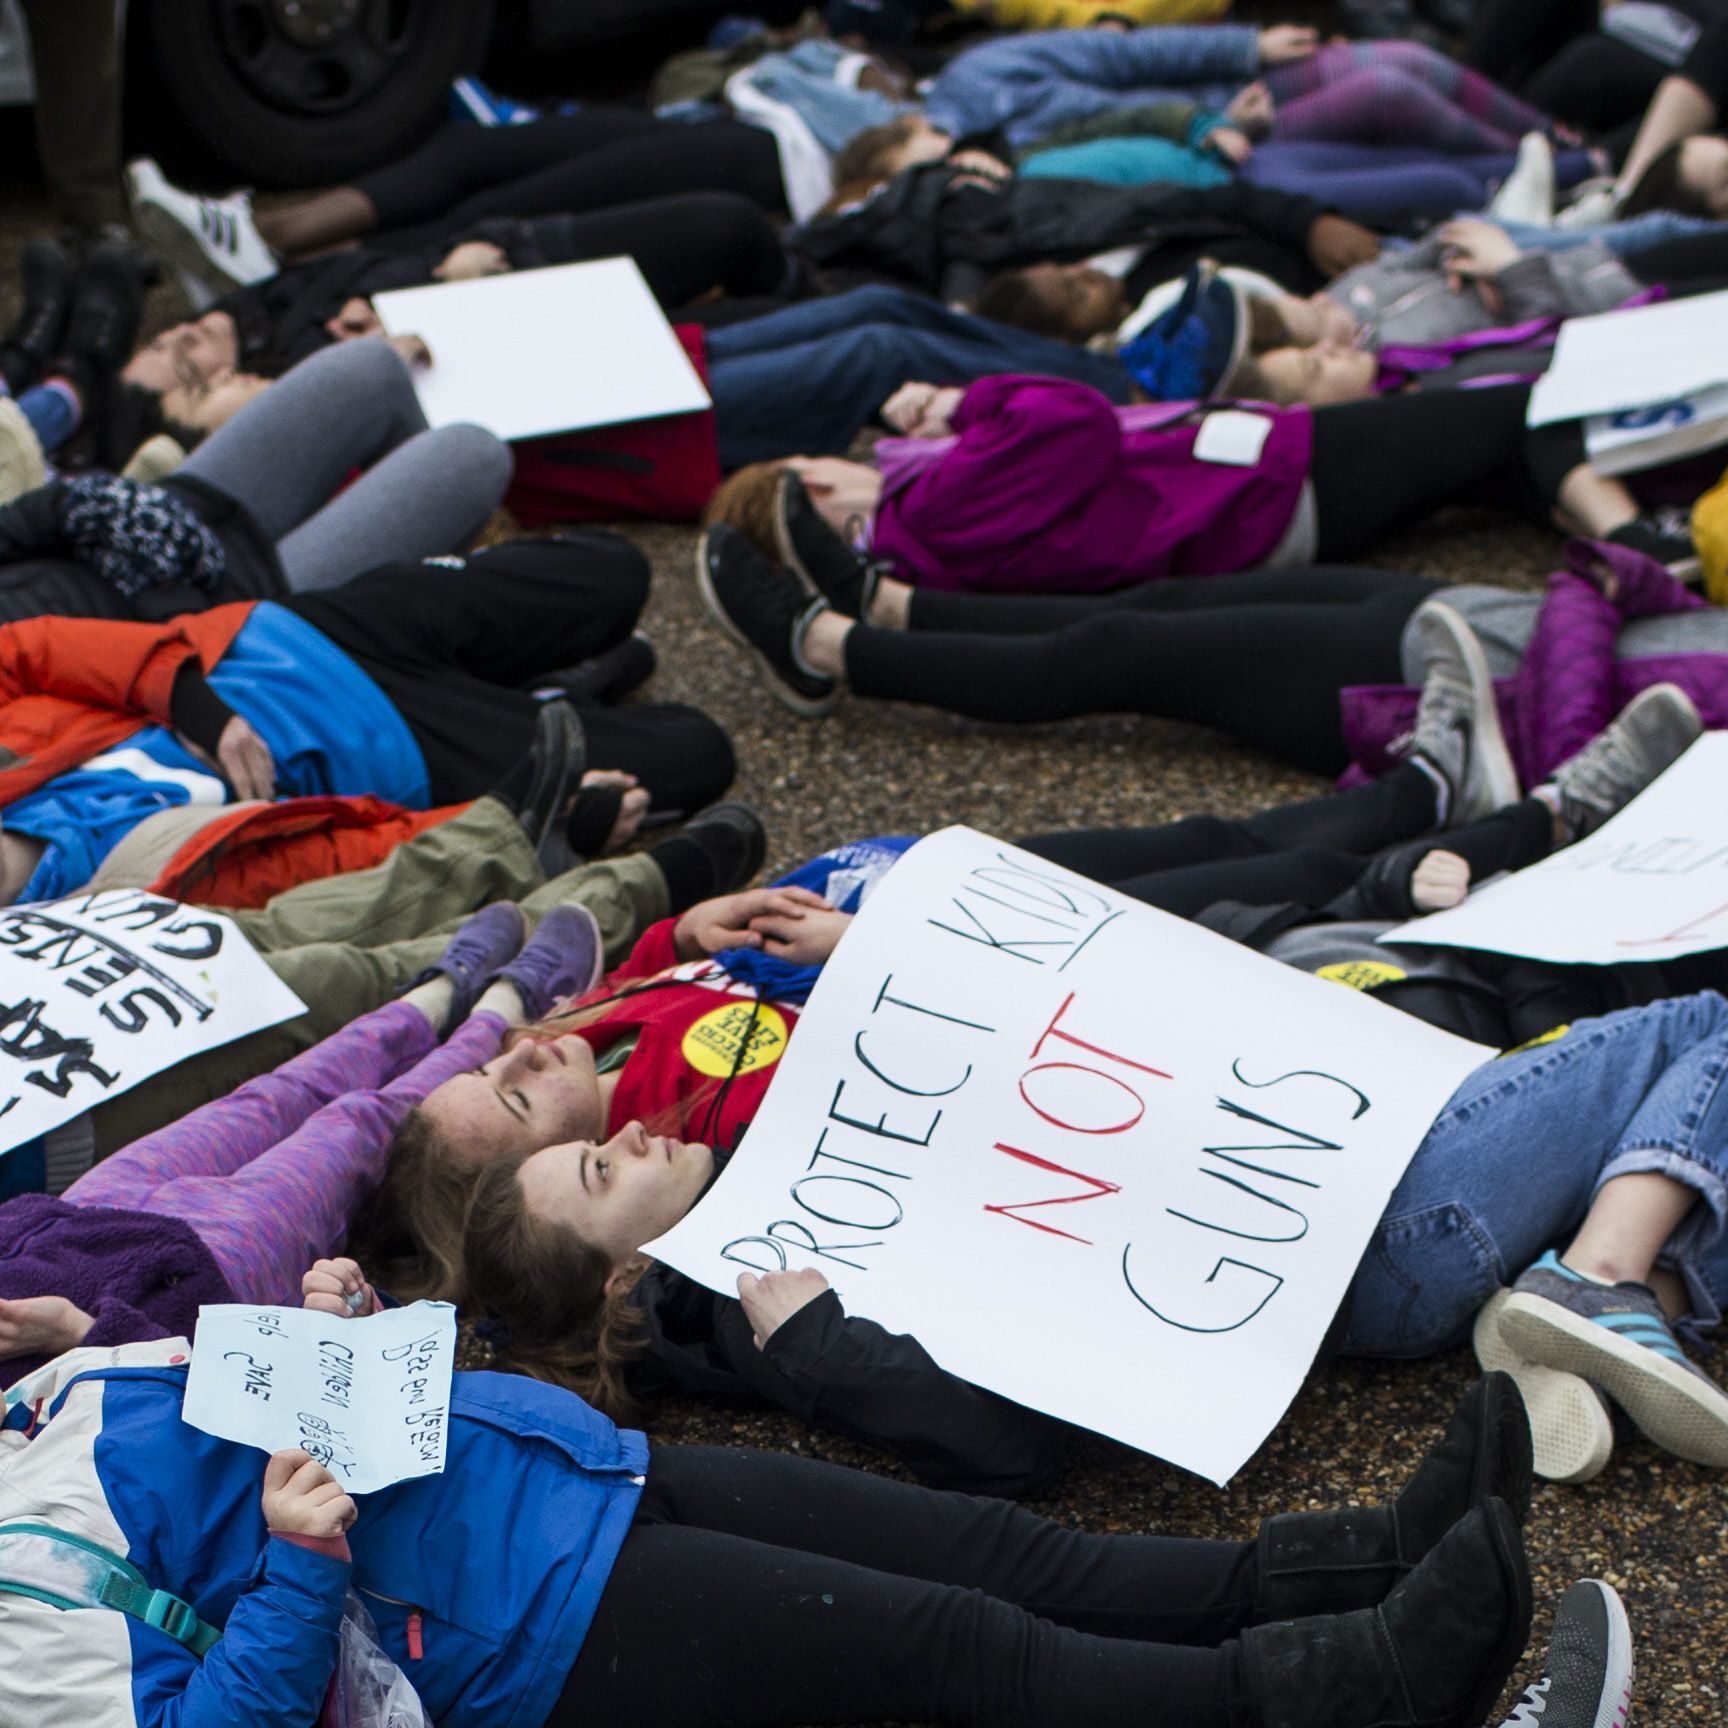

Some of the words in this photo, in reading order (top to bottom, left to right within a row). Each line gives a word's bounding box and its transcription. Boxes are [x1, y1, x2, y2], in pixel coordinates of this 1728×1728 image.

[719, 973, 996, 1297] PROTECT
[723, 1005, 781, 1045] LIES
[983, 991, 1173, 1246] NOT
[1122, 1057, 1371, 1333] GUNS
